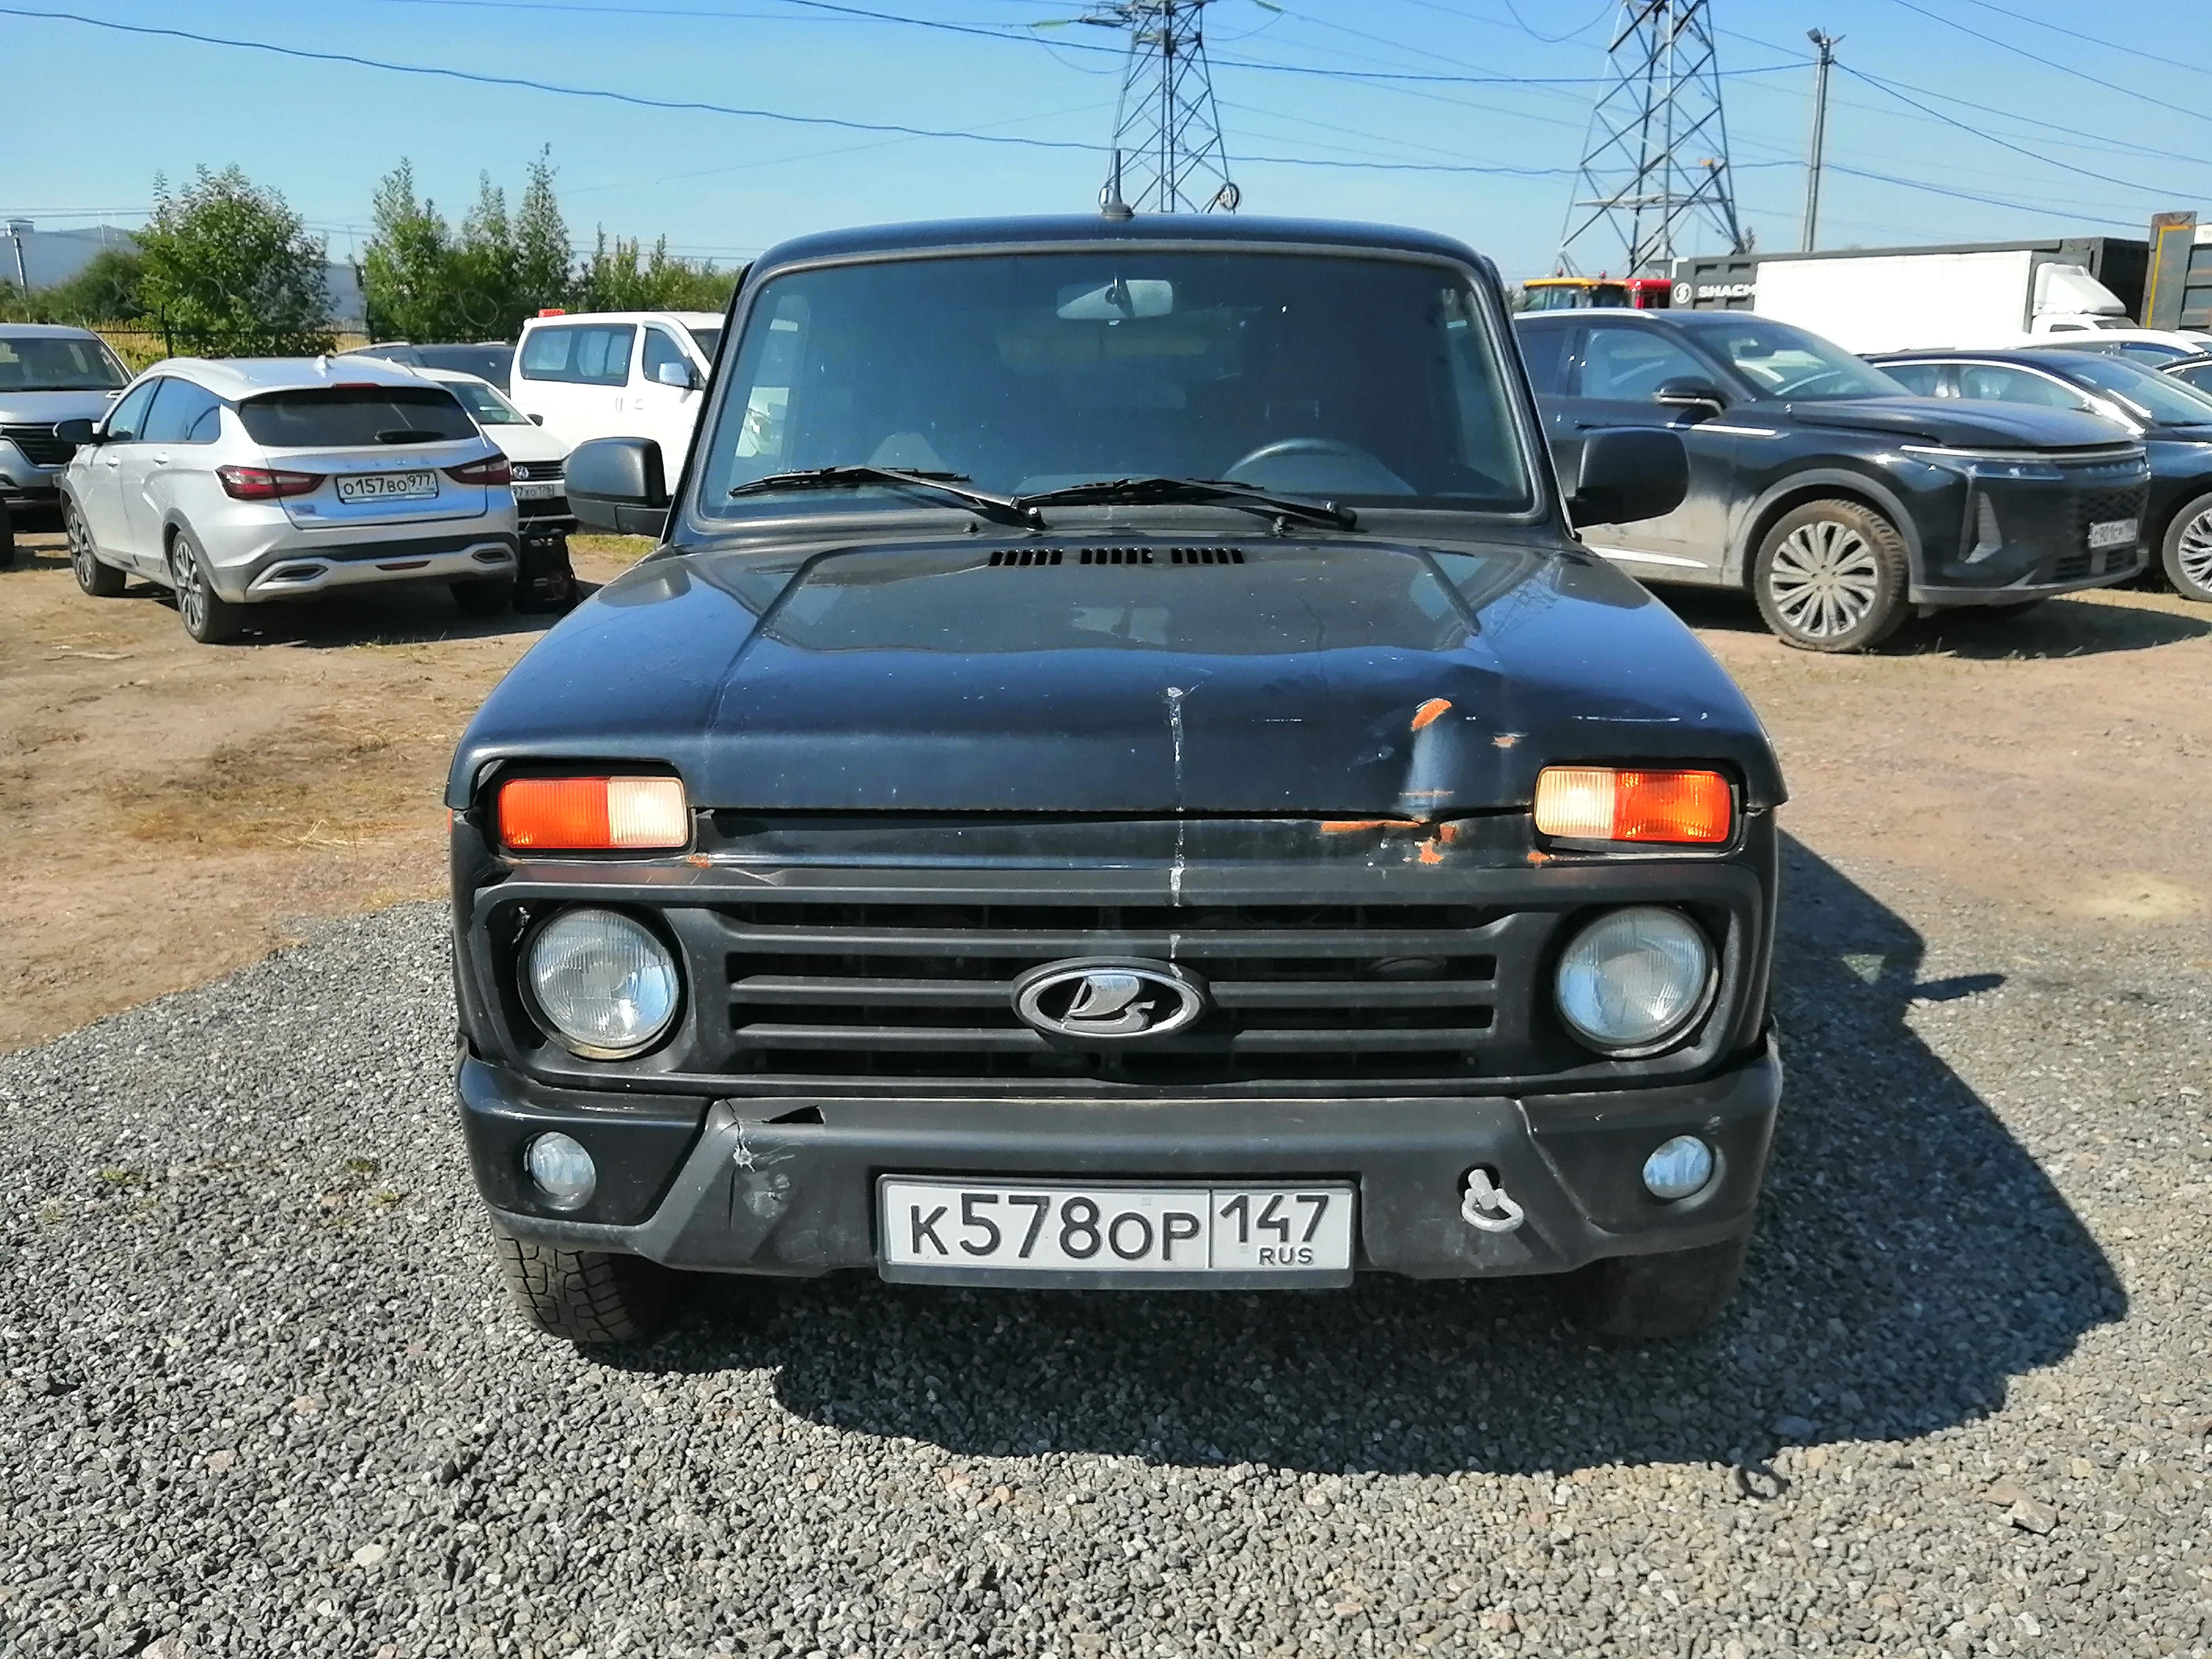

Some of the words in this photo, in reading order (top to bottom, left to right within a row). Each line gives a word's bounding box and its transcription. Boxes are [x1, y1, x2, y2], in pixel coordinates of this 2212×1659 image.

[408, 474, 430, 487] 977
[910, 1192, 1200, 1261] К578ОР
[1219, 1194, 1330, 1243] 147
[1258, 1248, 1314, 1265] RUS
